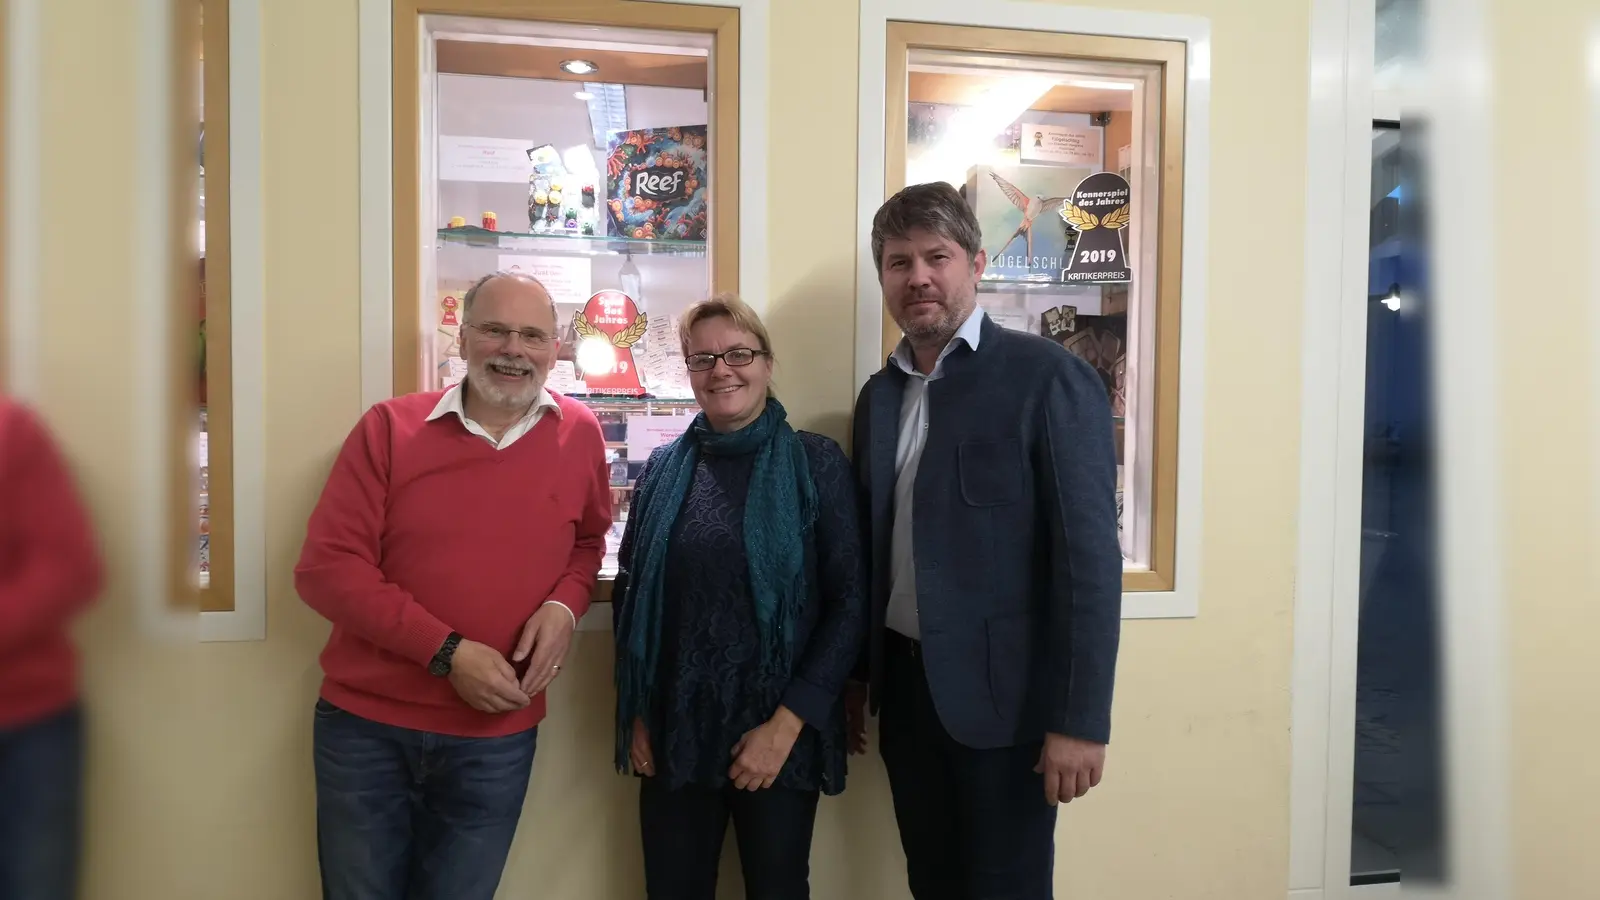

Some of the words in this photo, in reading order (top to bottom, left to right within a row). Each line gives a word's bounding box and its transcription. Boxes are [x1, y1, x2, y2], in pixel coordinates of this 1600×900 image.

[636, 171, 683, 194] Reef
[1077, 189, 1128, 199] Kennerspiel
[1079, 198, 1094, 206] des
[1096, 197, 1124, 206] Jahres
[1080, 250, 1117, 264] 2019
[990, 254, 1065, 270] LÜGELSCHL
[1068, 272, 1125, 280] KRITIKERPREIS
[603, 307, 623, 315] des
[594, 315, 628, 324] Jahres
